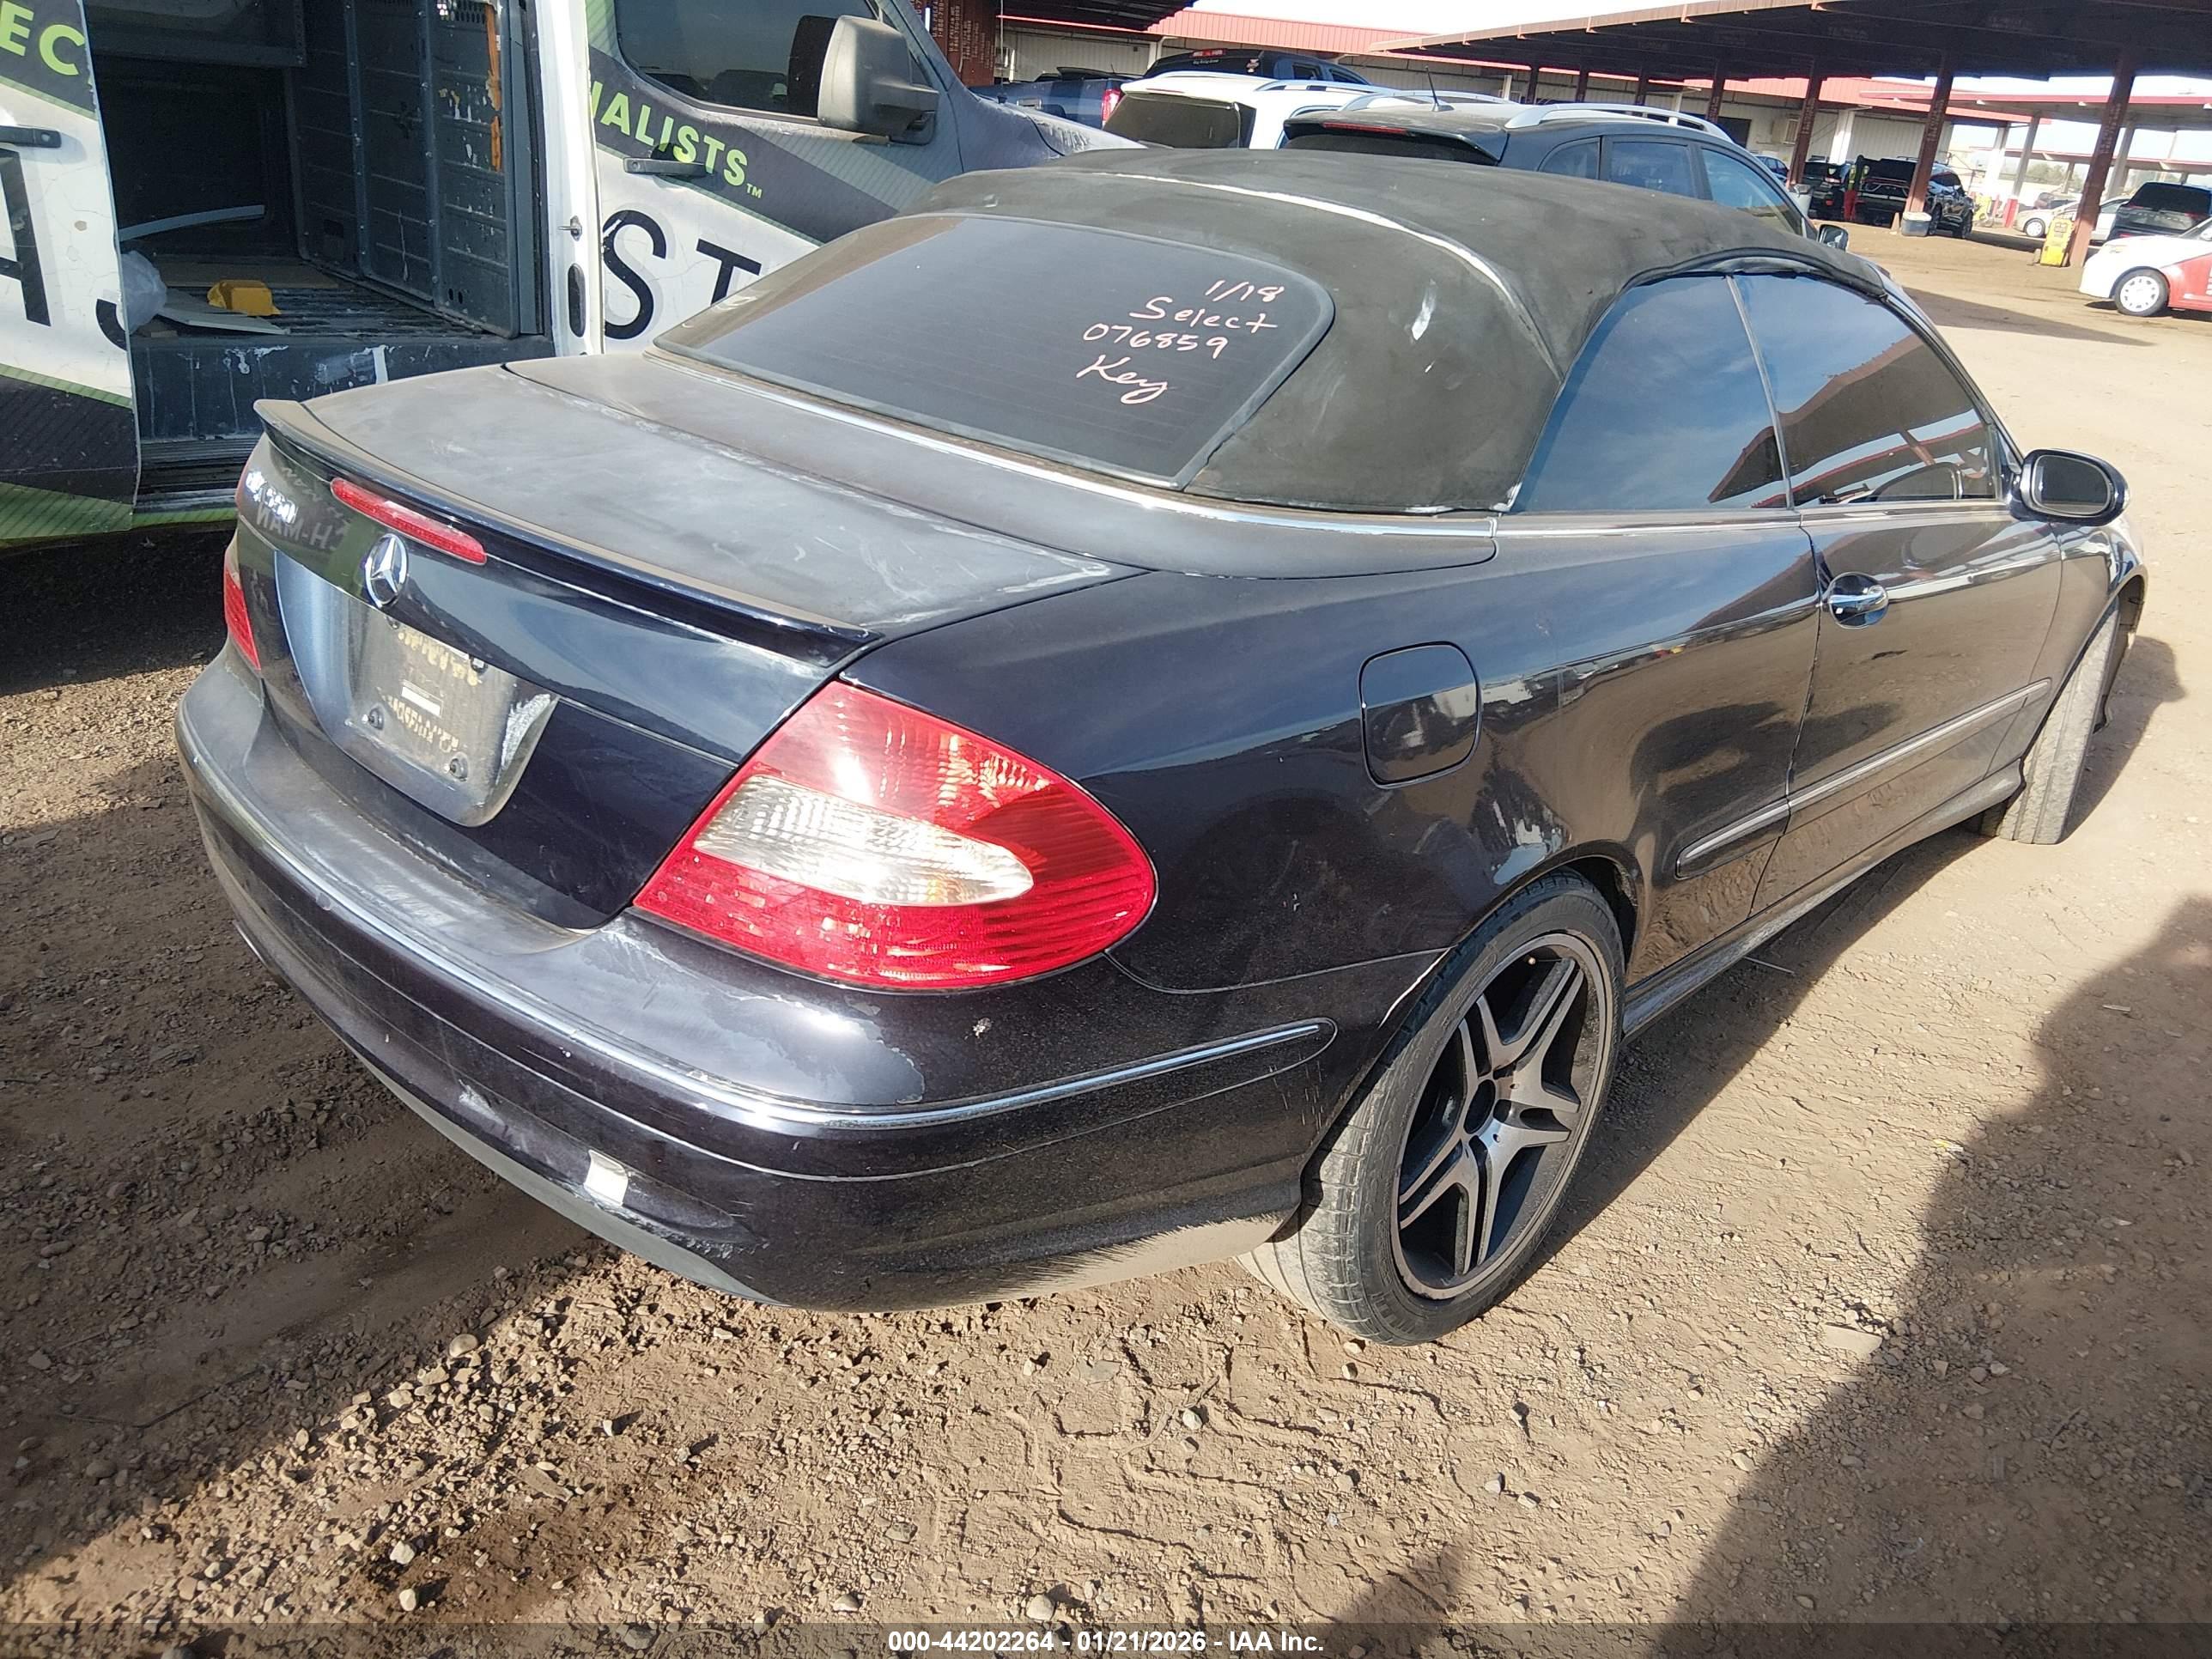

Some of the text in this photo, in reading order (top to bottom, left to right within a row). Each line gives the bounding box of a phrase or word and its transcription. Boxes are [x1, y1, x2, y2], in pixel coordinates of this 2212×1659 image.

[1205, 279, 1284, 302] 1/18
[1129, 296, 1278, 333] Select
[1083, 323, 1229, 359] 076859
[1076, 354, 1169, 404] Key
